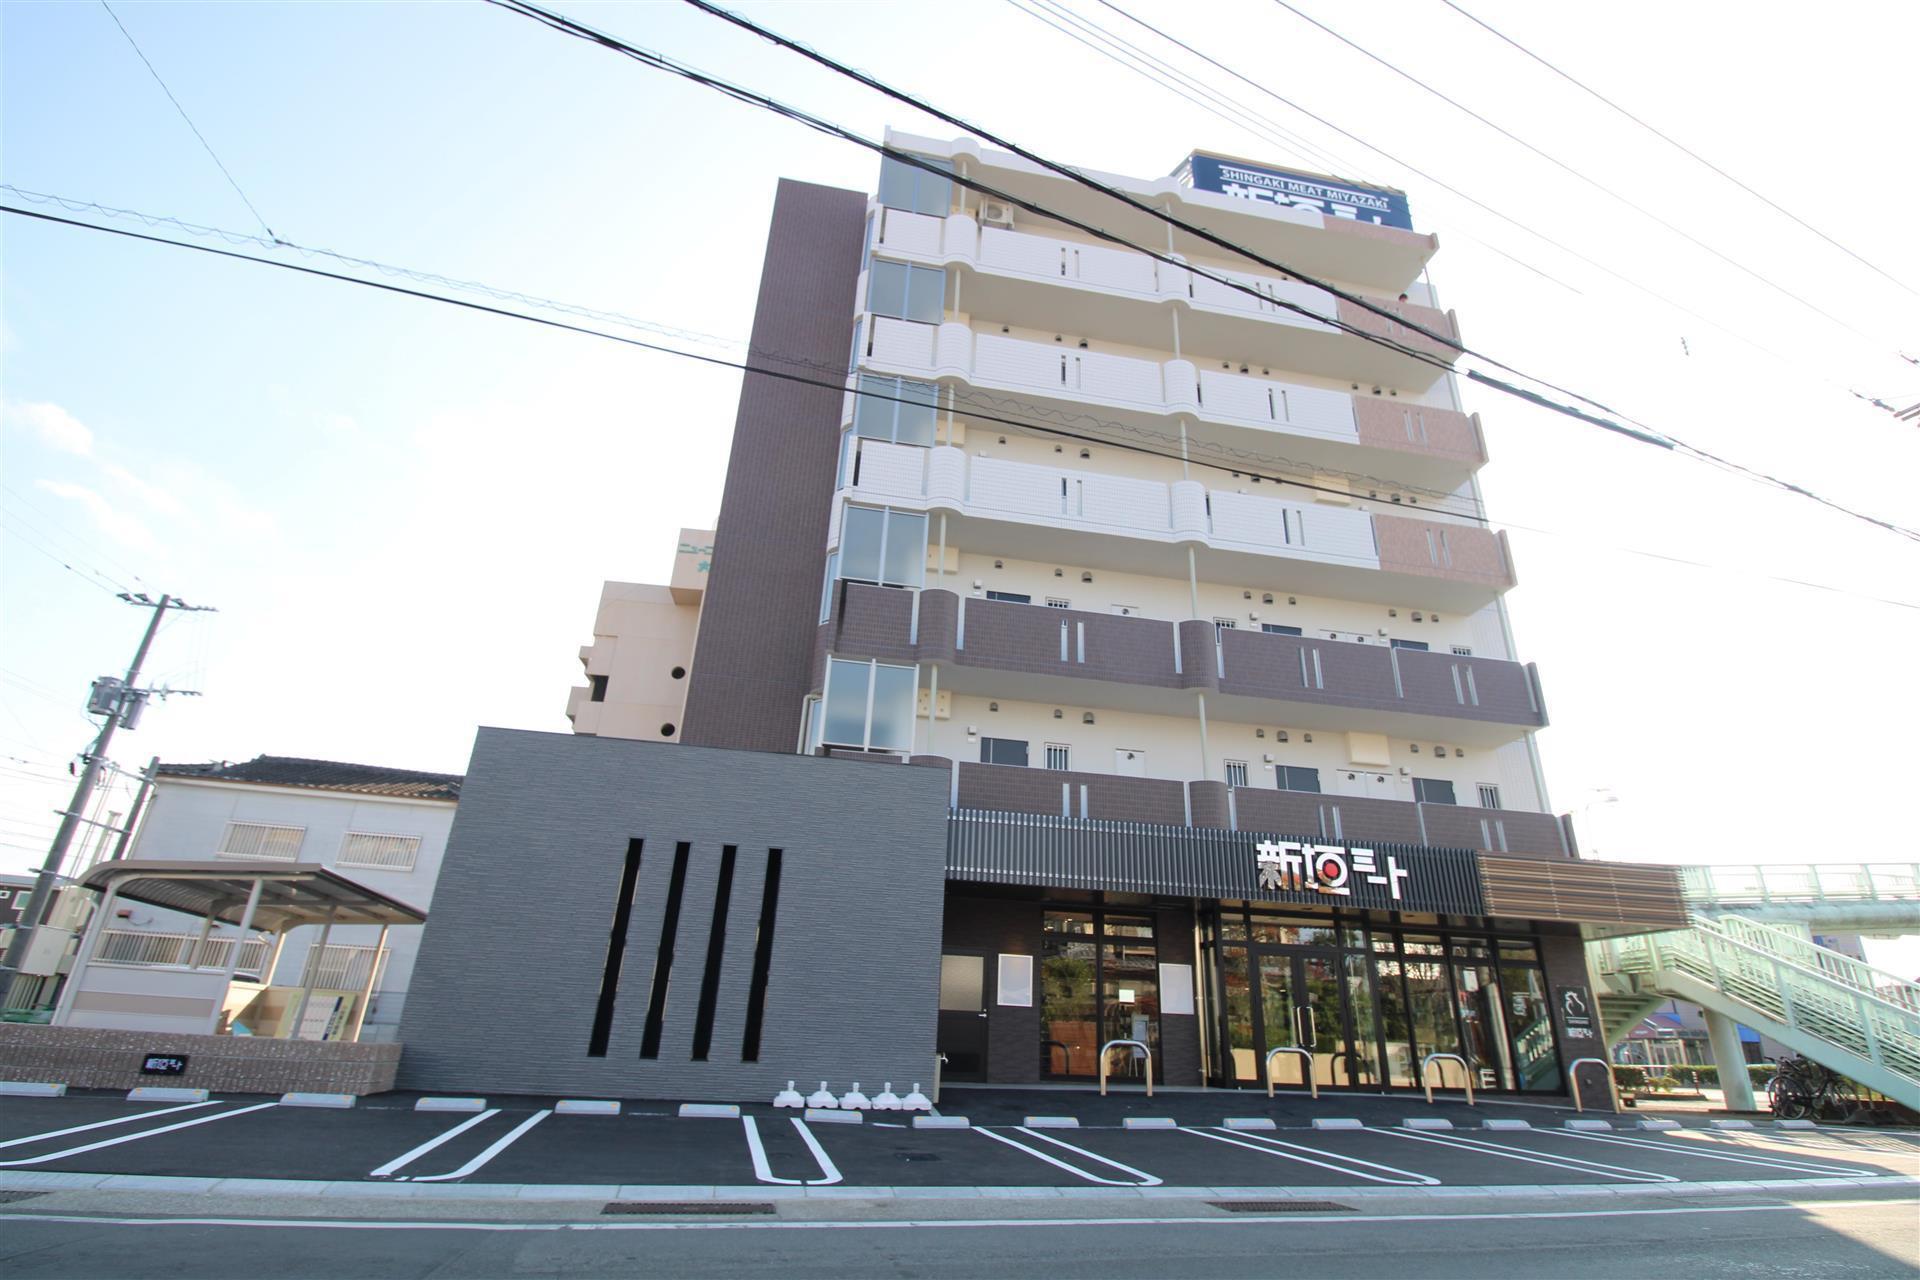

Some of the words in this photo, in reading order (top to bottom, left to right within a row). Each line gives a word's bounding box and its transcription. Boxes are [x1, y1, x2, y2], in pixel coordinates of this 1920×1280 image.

[1222, 169, 1285, 189] SHINGAKI
[1287, 182, 1322, 196] MEAT
[1326, 190, 1388, 209] MIYAZAKI
[1256, 839, 1408, 900] 新垣ミート
